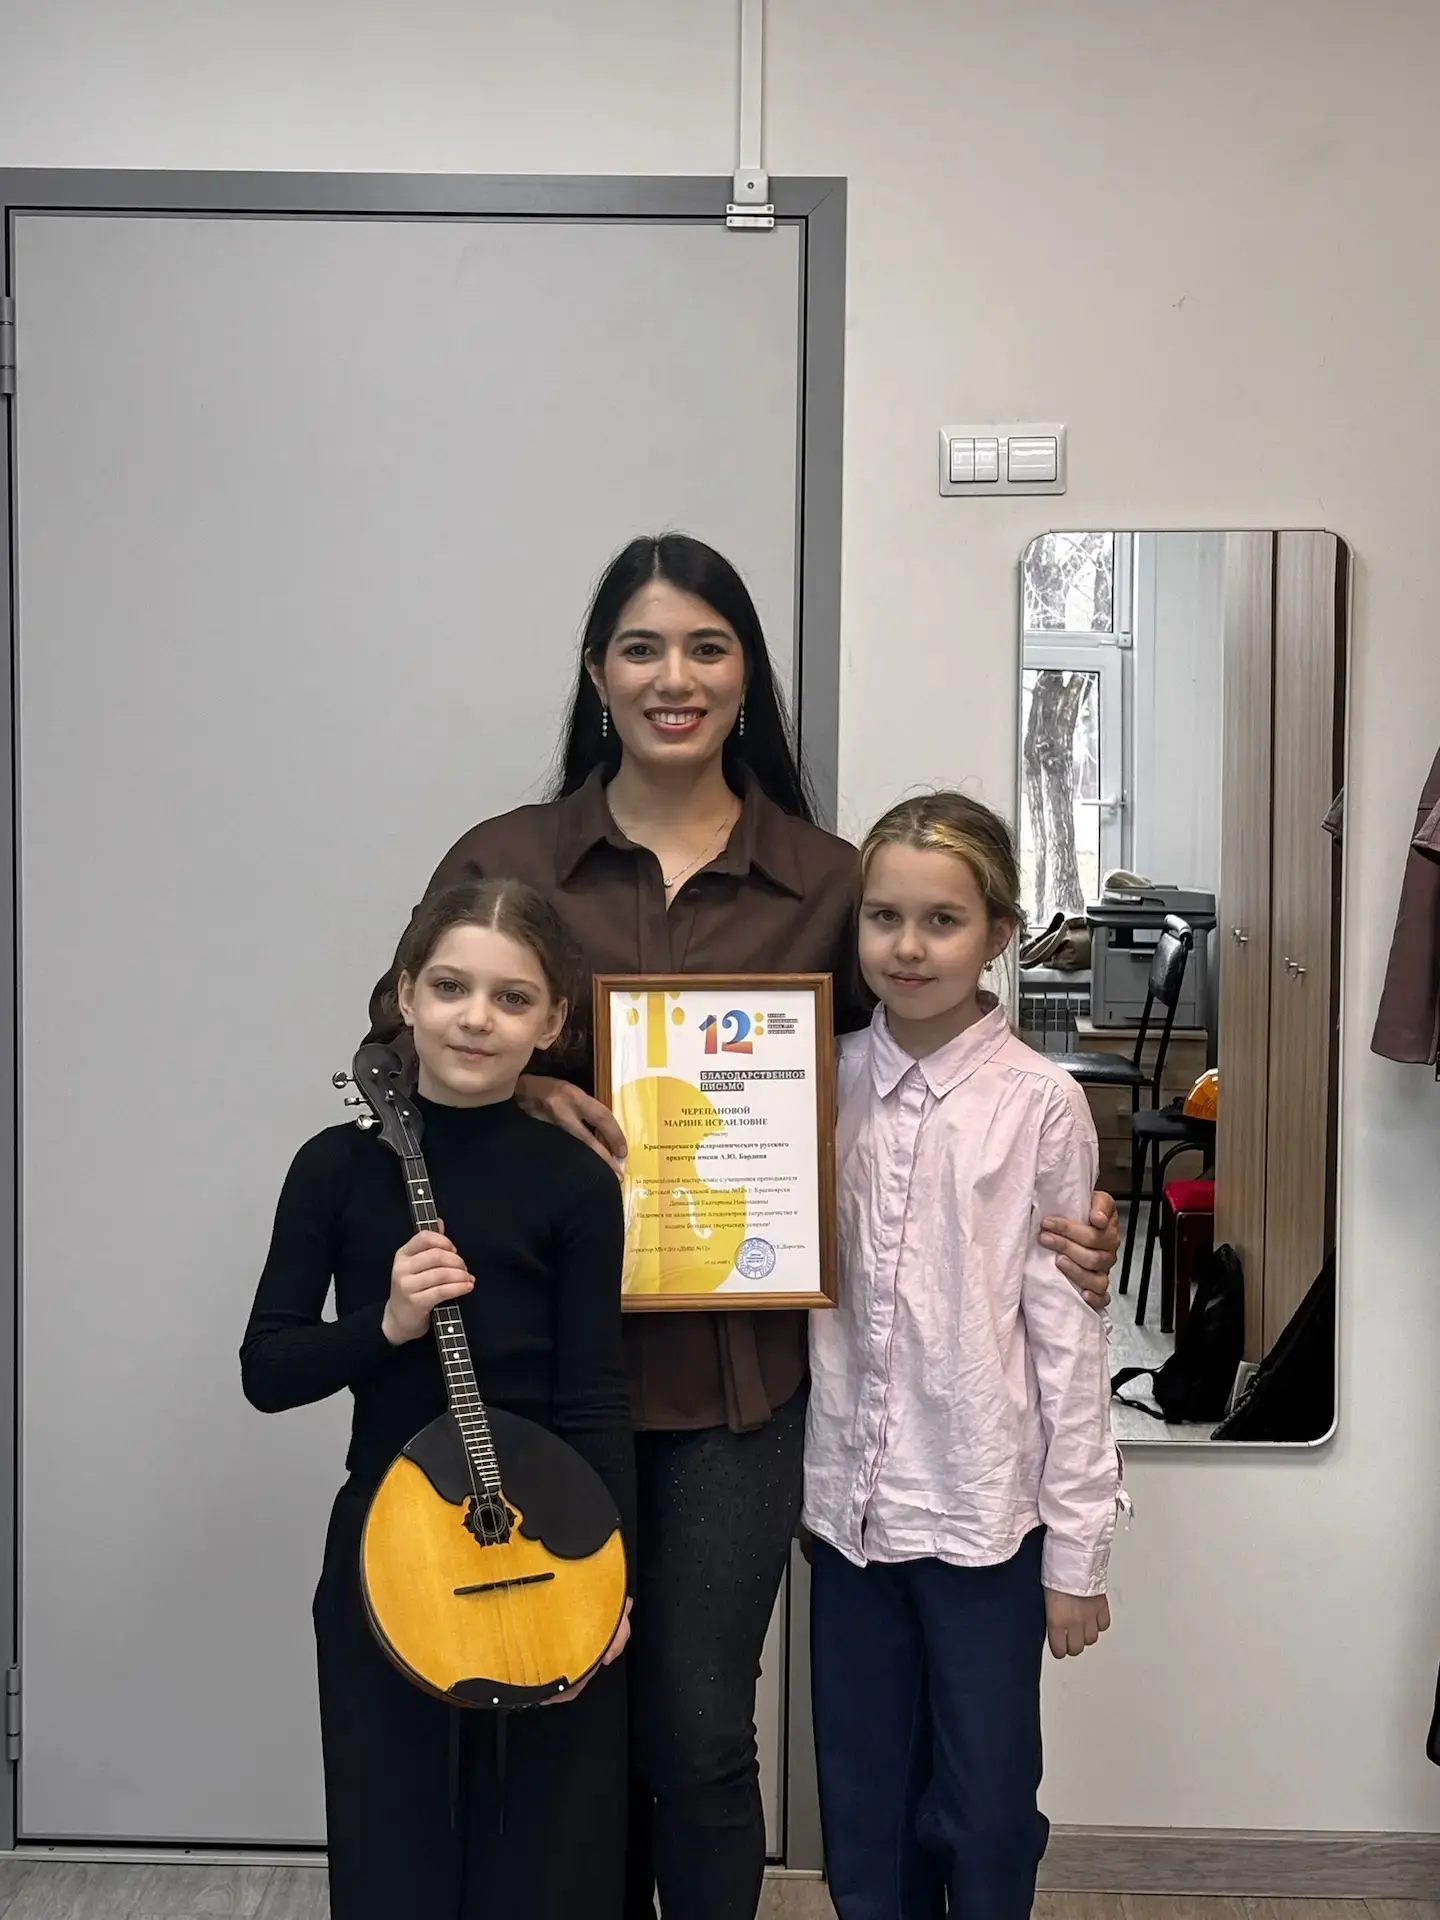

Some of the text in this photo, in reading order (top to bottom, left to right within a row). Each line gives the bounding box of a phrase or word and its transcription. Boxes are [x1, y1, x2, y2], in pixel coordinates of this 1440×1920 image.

[699, 1010, 753, 1054] 12
[701, 1070, 805, 1080] БЛАГОДАРСТВЕННОЕ
[701, 1082, 744, 1091] ПИСЬМО
[681, 1106, 750, 1116] ЧЕРЕПАНОВОЙ
[664, 1119, 703, 1128] МАРИНЕ
[643, 1143, 694, 1151] Красноярского
